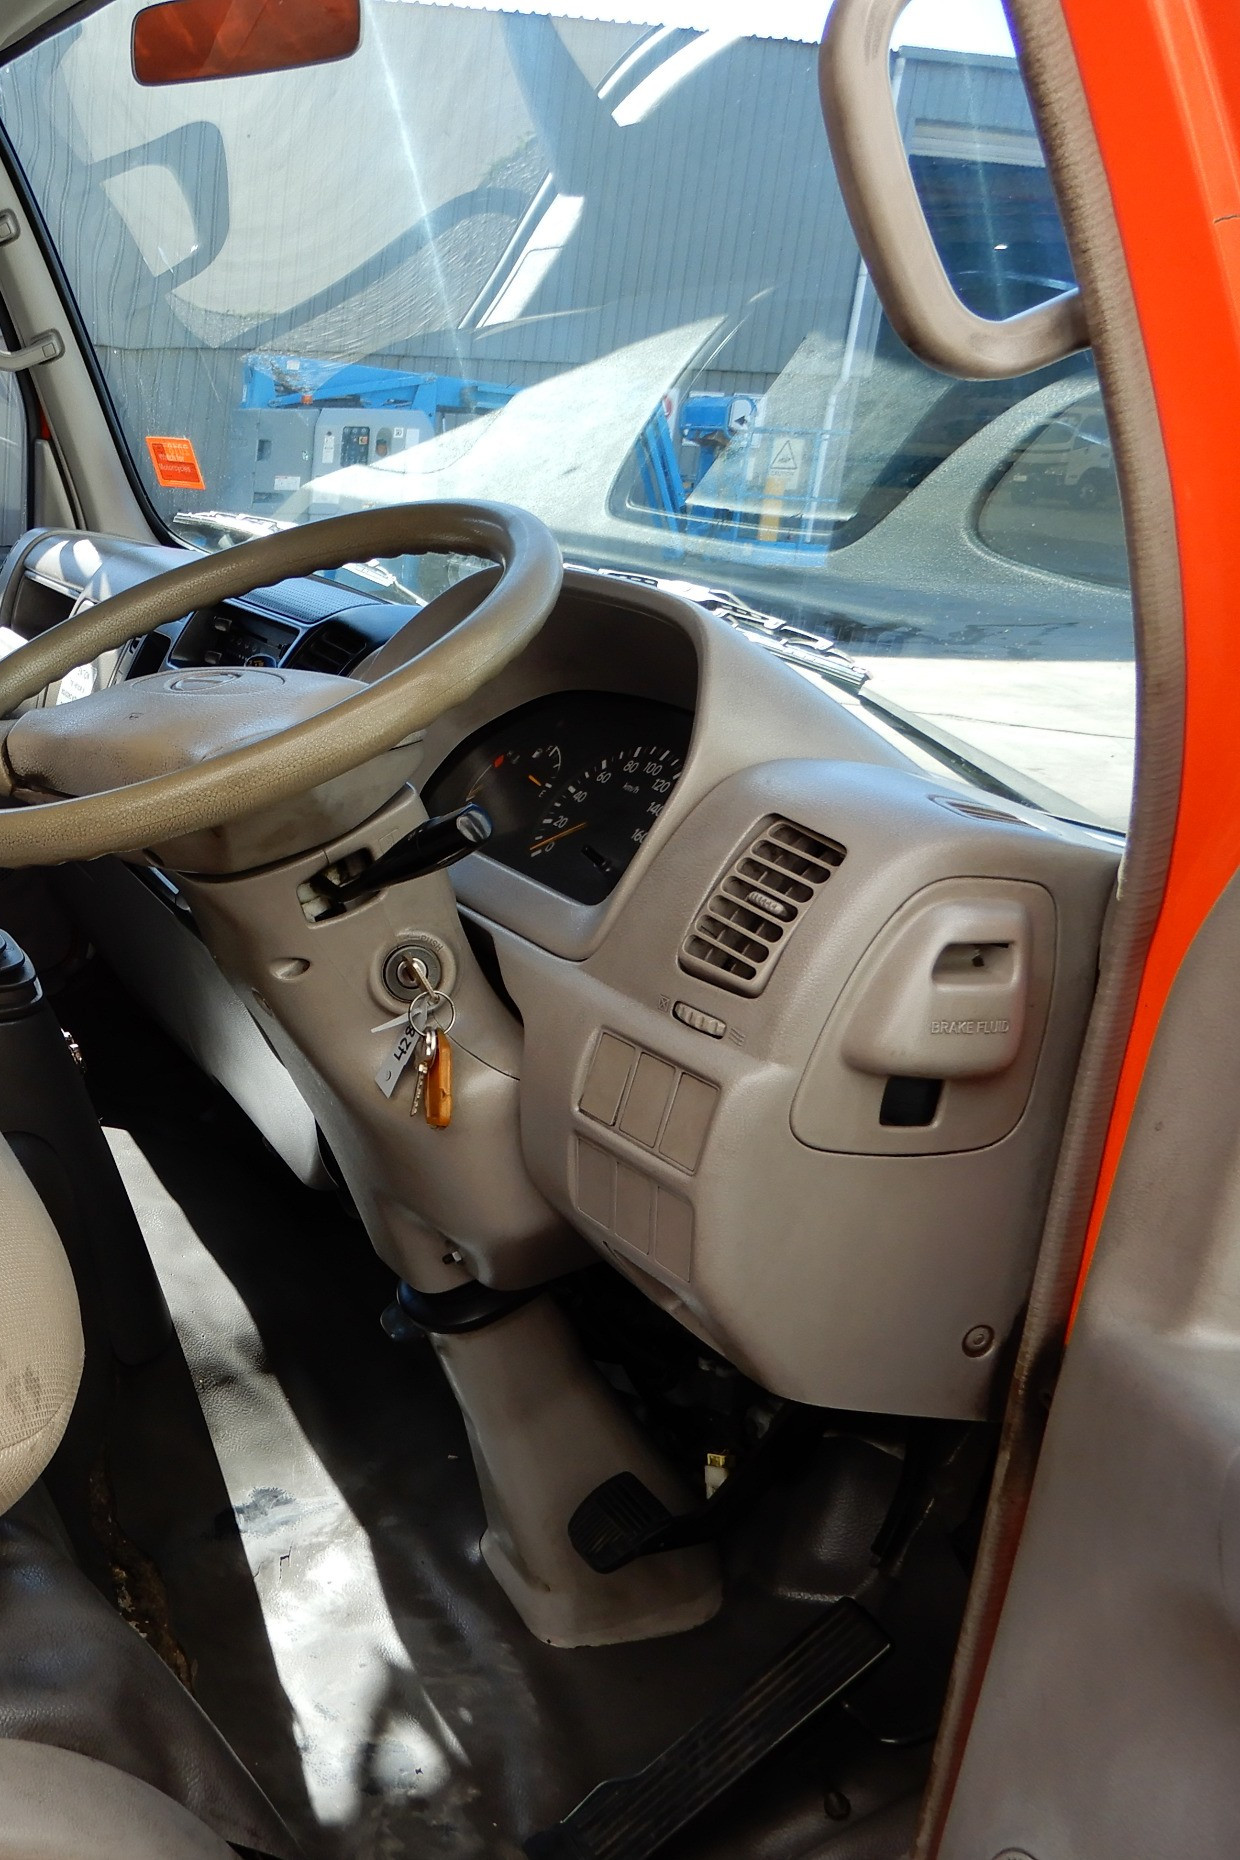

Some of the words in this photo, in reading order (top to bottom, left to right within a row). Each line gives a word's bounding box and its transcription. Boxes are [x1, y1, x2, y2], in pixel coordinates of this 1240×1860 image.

[623, 760, 639, 773] 80
[643, 761, 663, 776] 100
[596, 771, 612, 784] 60
[651, 778, 671, 793] 120
[573, 790, 588, 803] 40
[552, 815, 568, 828] 20
[544, 841, 555, 853] 0
[420, 934, 444, 952] PUSH
[931, 1020, 974, 1035] BRAKE
[976, 1020, 1009, 1034] FLUID
[394, 1025, 416, 1062] 428
